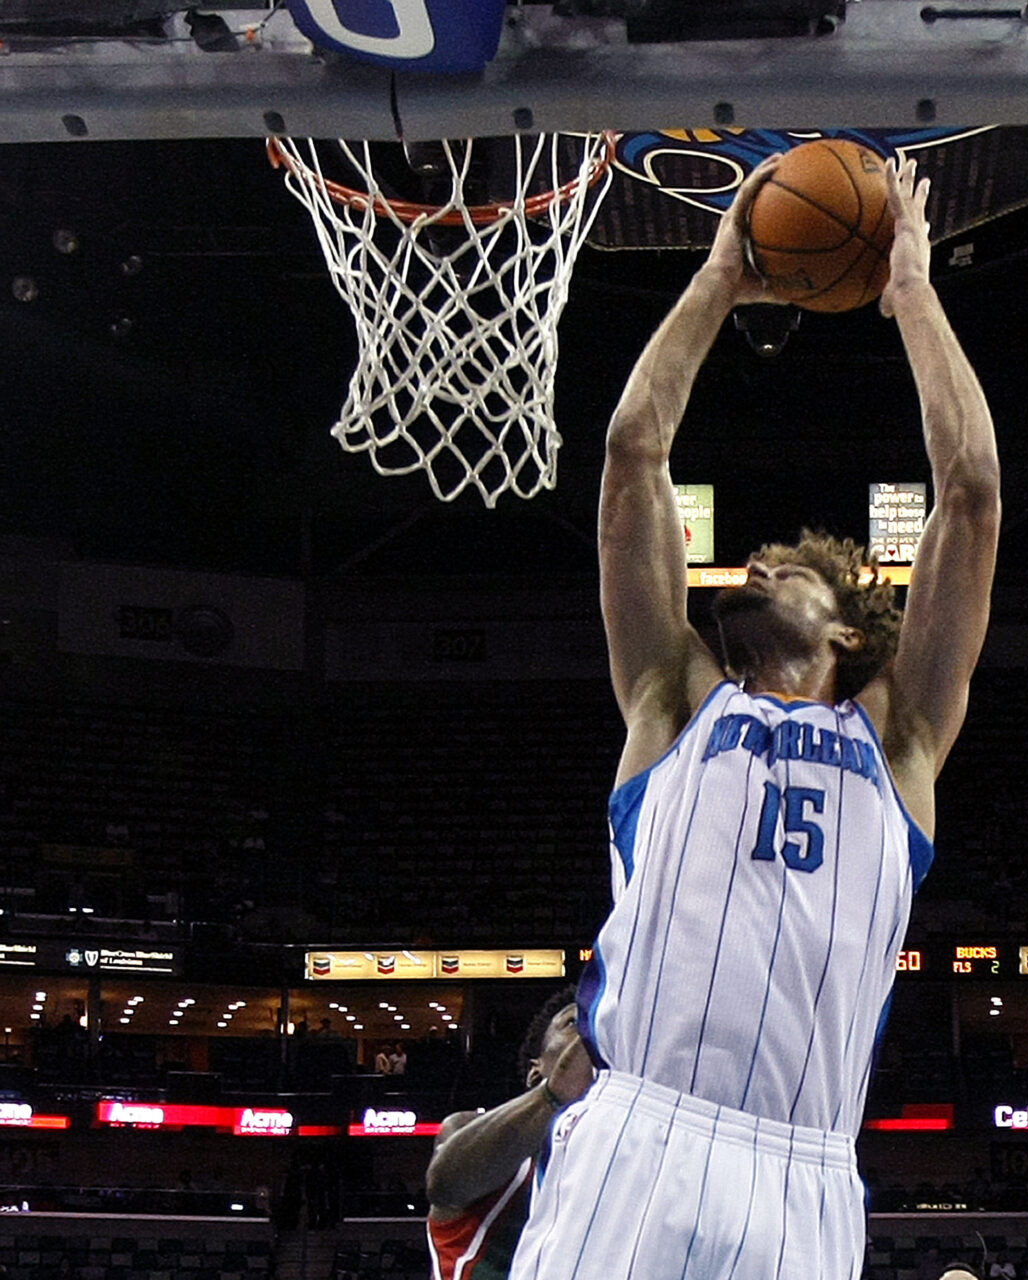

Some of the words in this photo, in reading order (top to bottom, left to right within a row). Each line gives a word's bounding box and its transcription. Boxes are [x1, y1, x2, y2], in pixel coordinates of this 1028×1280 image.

[880, 484, 895, 492] The
[874, 493, 913, 507] power
[680, 506, 711, 522] eople
[869, 505, 896, 521] help
[888, 518, 924, 533] need
[700, 572, 748, 586] faceboo
[751, 781, 827, 873] 15
[895, 951, 920, 971] 60
[956, 947, 997, 959] BUCKS
[109, 1103, 164, 1123] Acme
[241, 1108, 293, 1127] Acme
[364, 1108, 416, 1127] Acme
